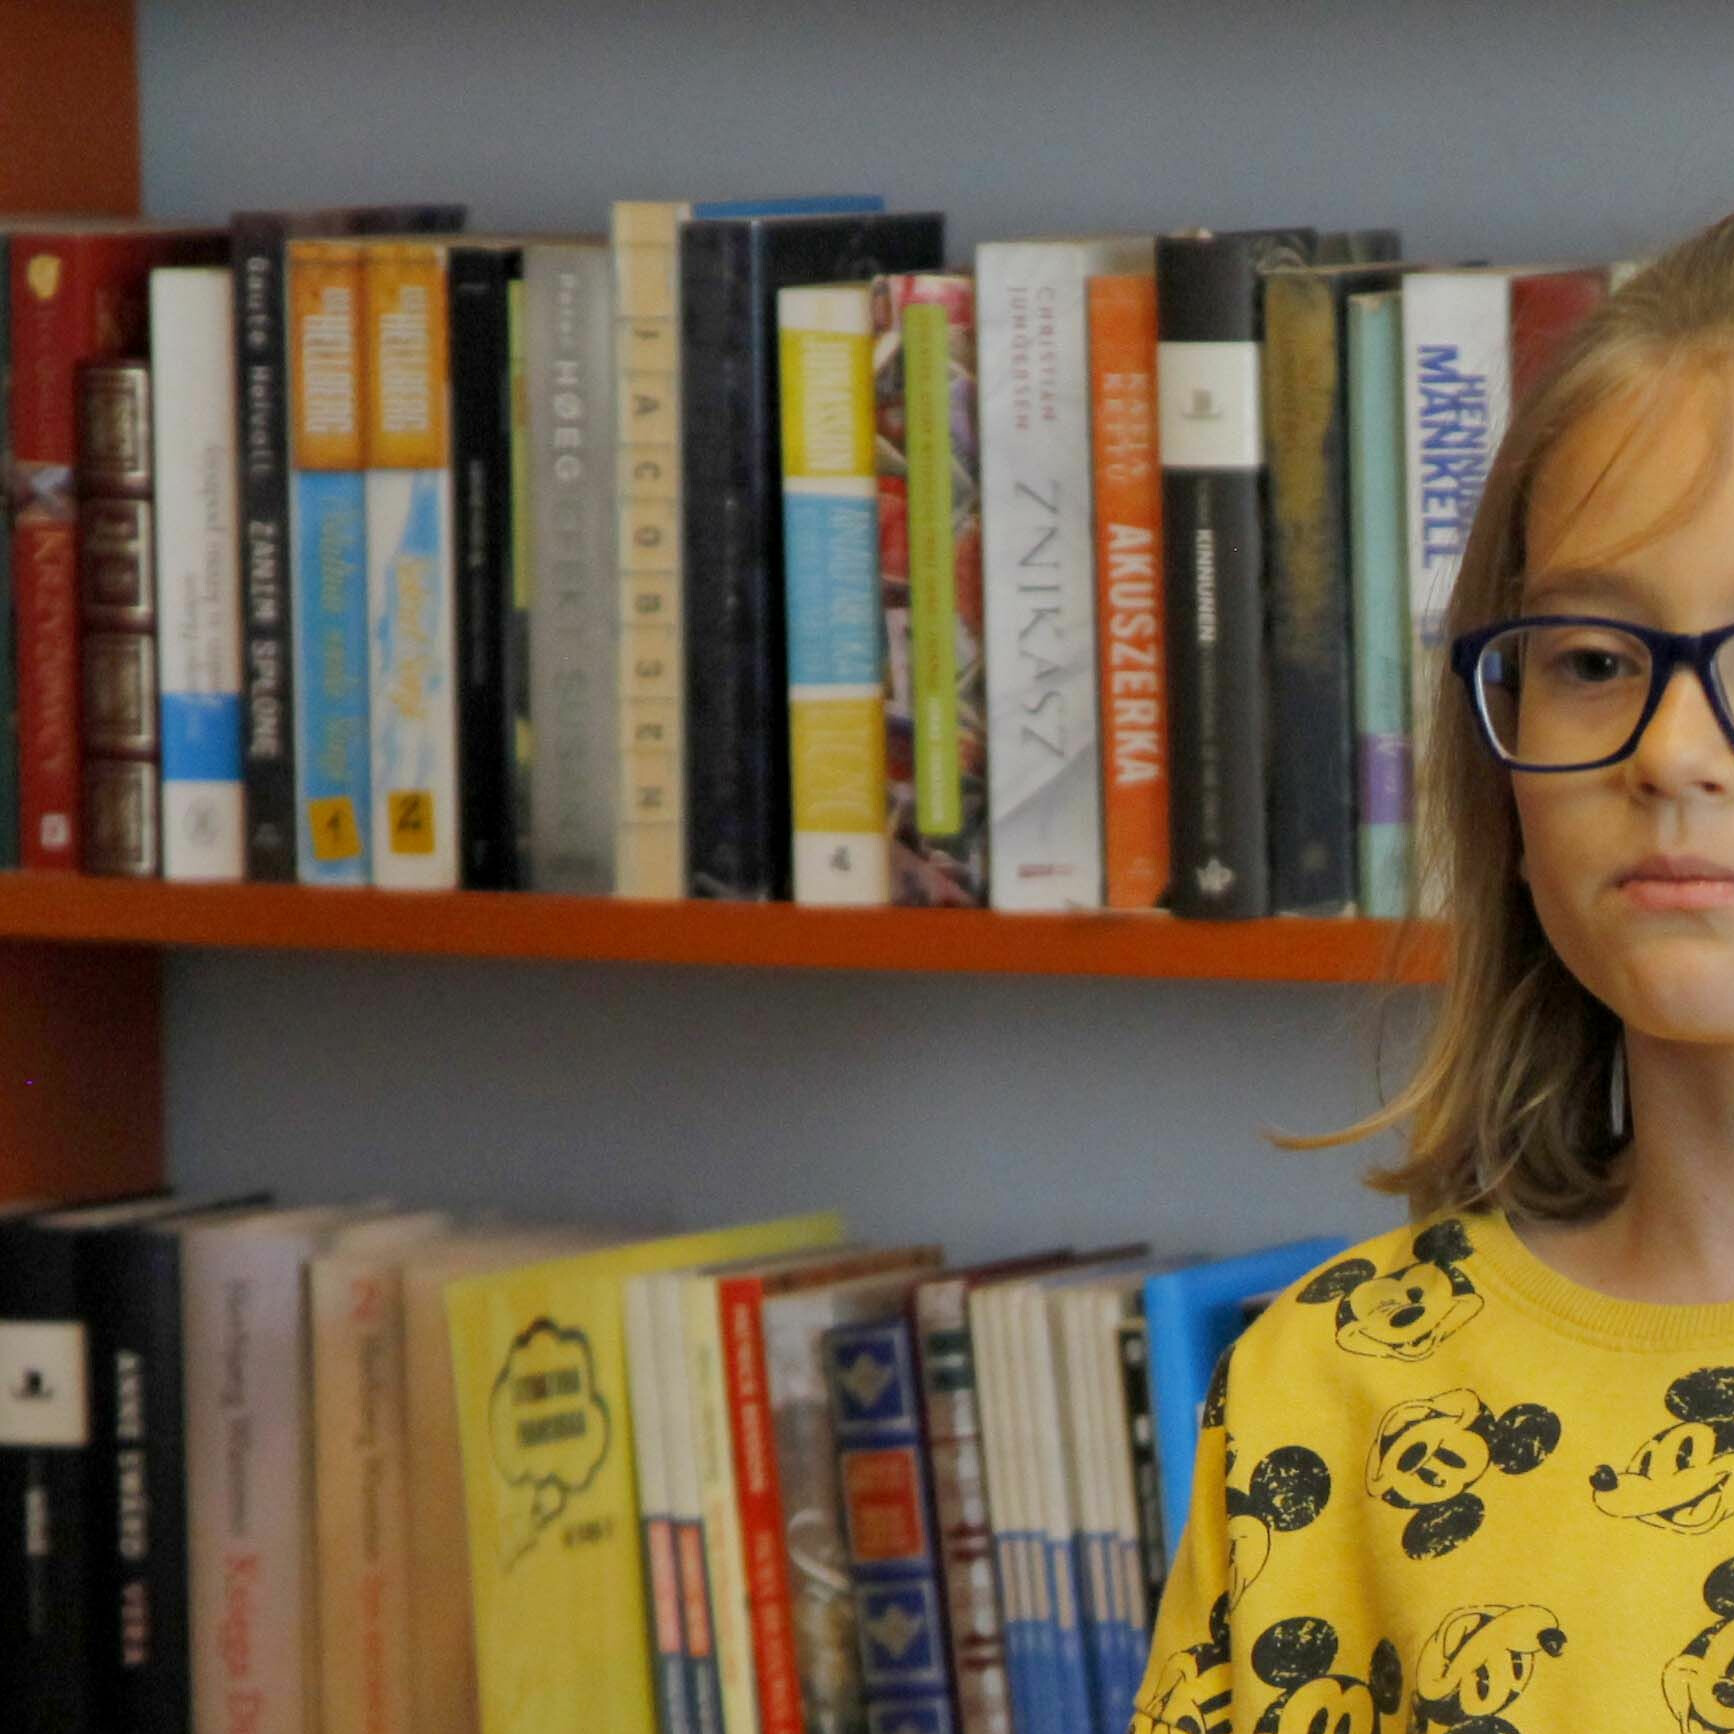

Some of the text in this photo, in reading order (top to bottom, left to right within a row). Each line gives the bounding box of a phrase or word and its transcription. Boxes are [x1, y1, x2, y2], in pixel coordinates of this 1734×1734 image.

[247, 256, 274, 348] Gaute
[1037, 286, 1058, 424] CHRISTIAN
[303, 315, 355, 433] HELLBERG
[551, 359, 583, 480] HØEG
[1417, 344, 1460, 571] MANKELL
[249, 520, 281, 621] ZANIM
[1011, 478, 1069, 762] ZNIKASZ
[1193, 528, 1218, 643] KINNUNEN
[1104, 521, 1161, 787] AKUSZERKA
[395, 793, 424, 834] 2
